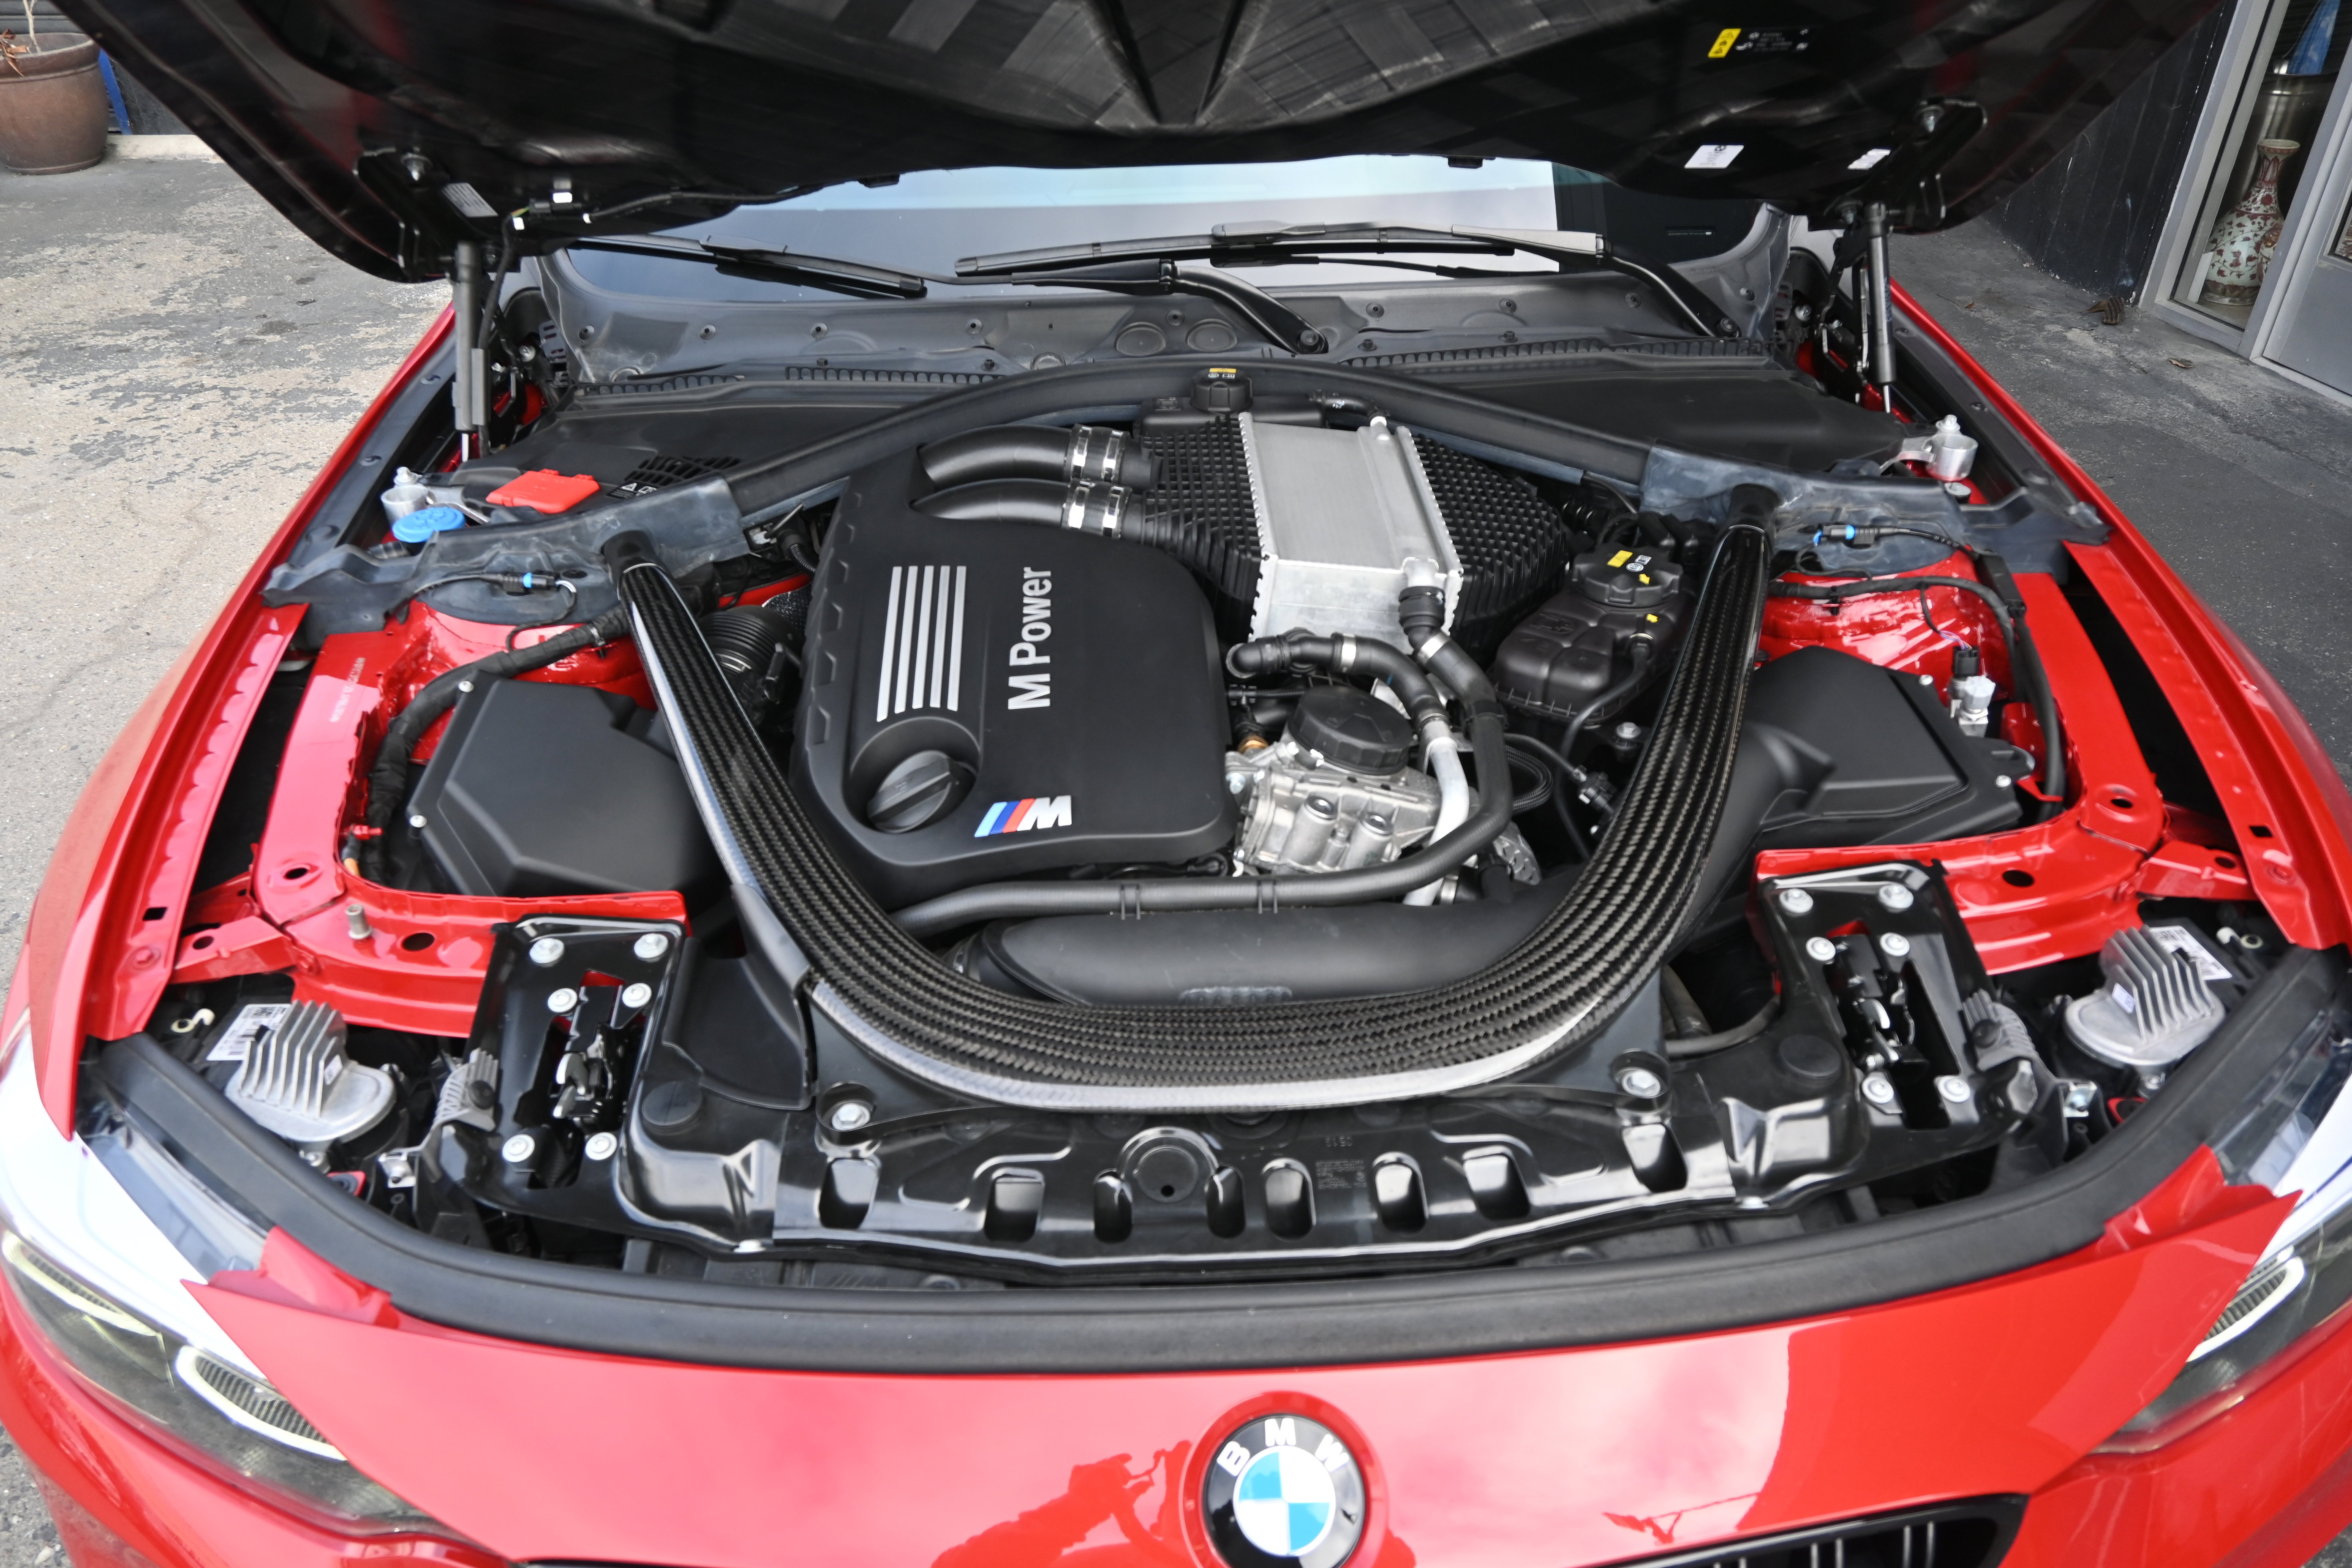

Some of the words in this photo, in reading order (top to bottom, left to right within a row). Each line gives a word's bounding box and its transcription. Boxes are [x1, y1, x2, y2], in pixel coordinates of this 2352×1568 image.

[1008, 566, 1052, 666] Power
[1007, 672, 1051, 710] M
[1016, 795, 1073, 831] M
